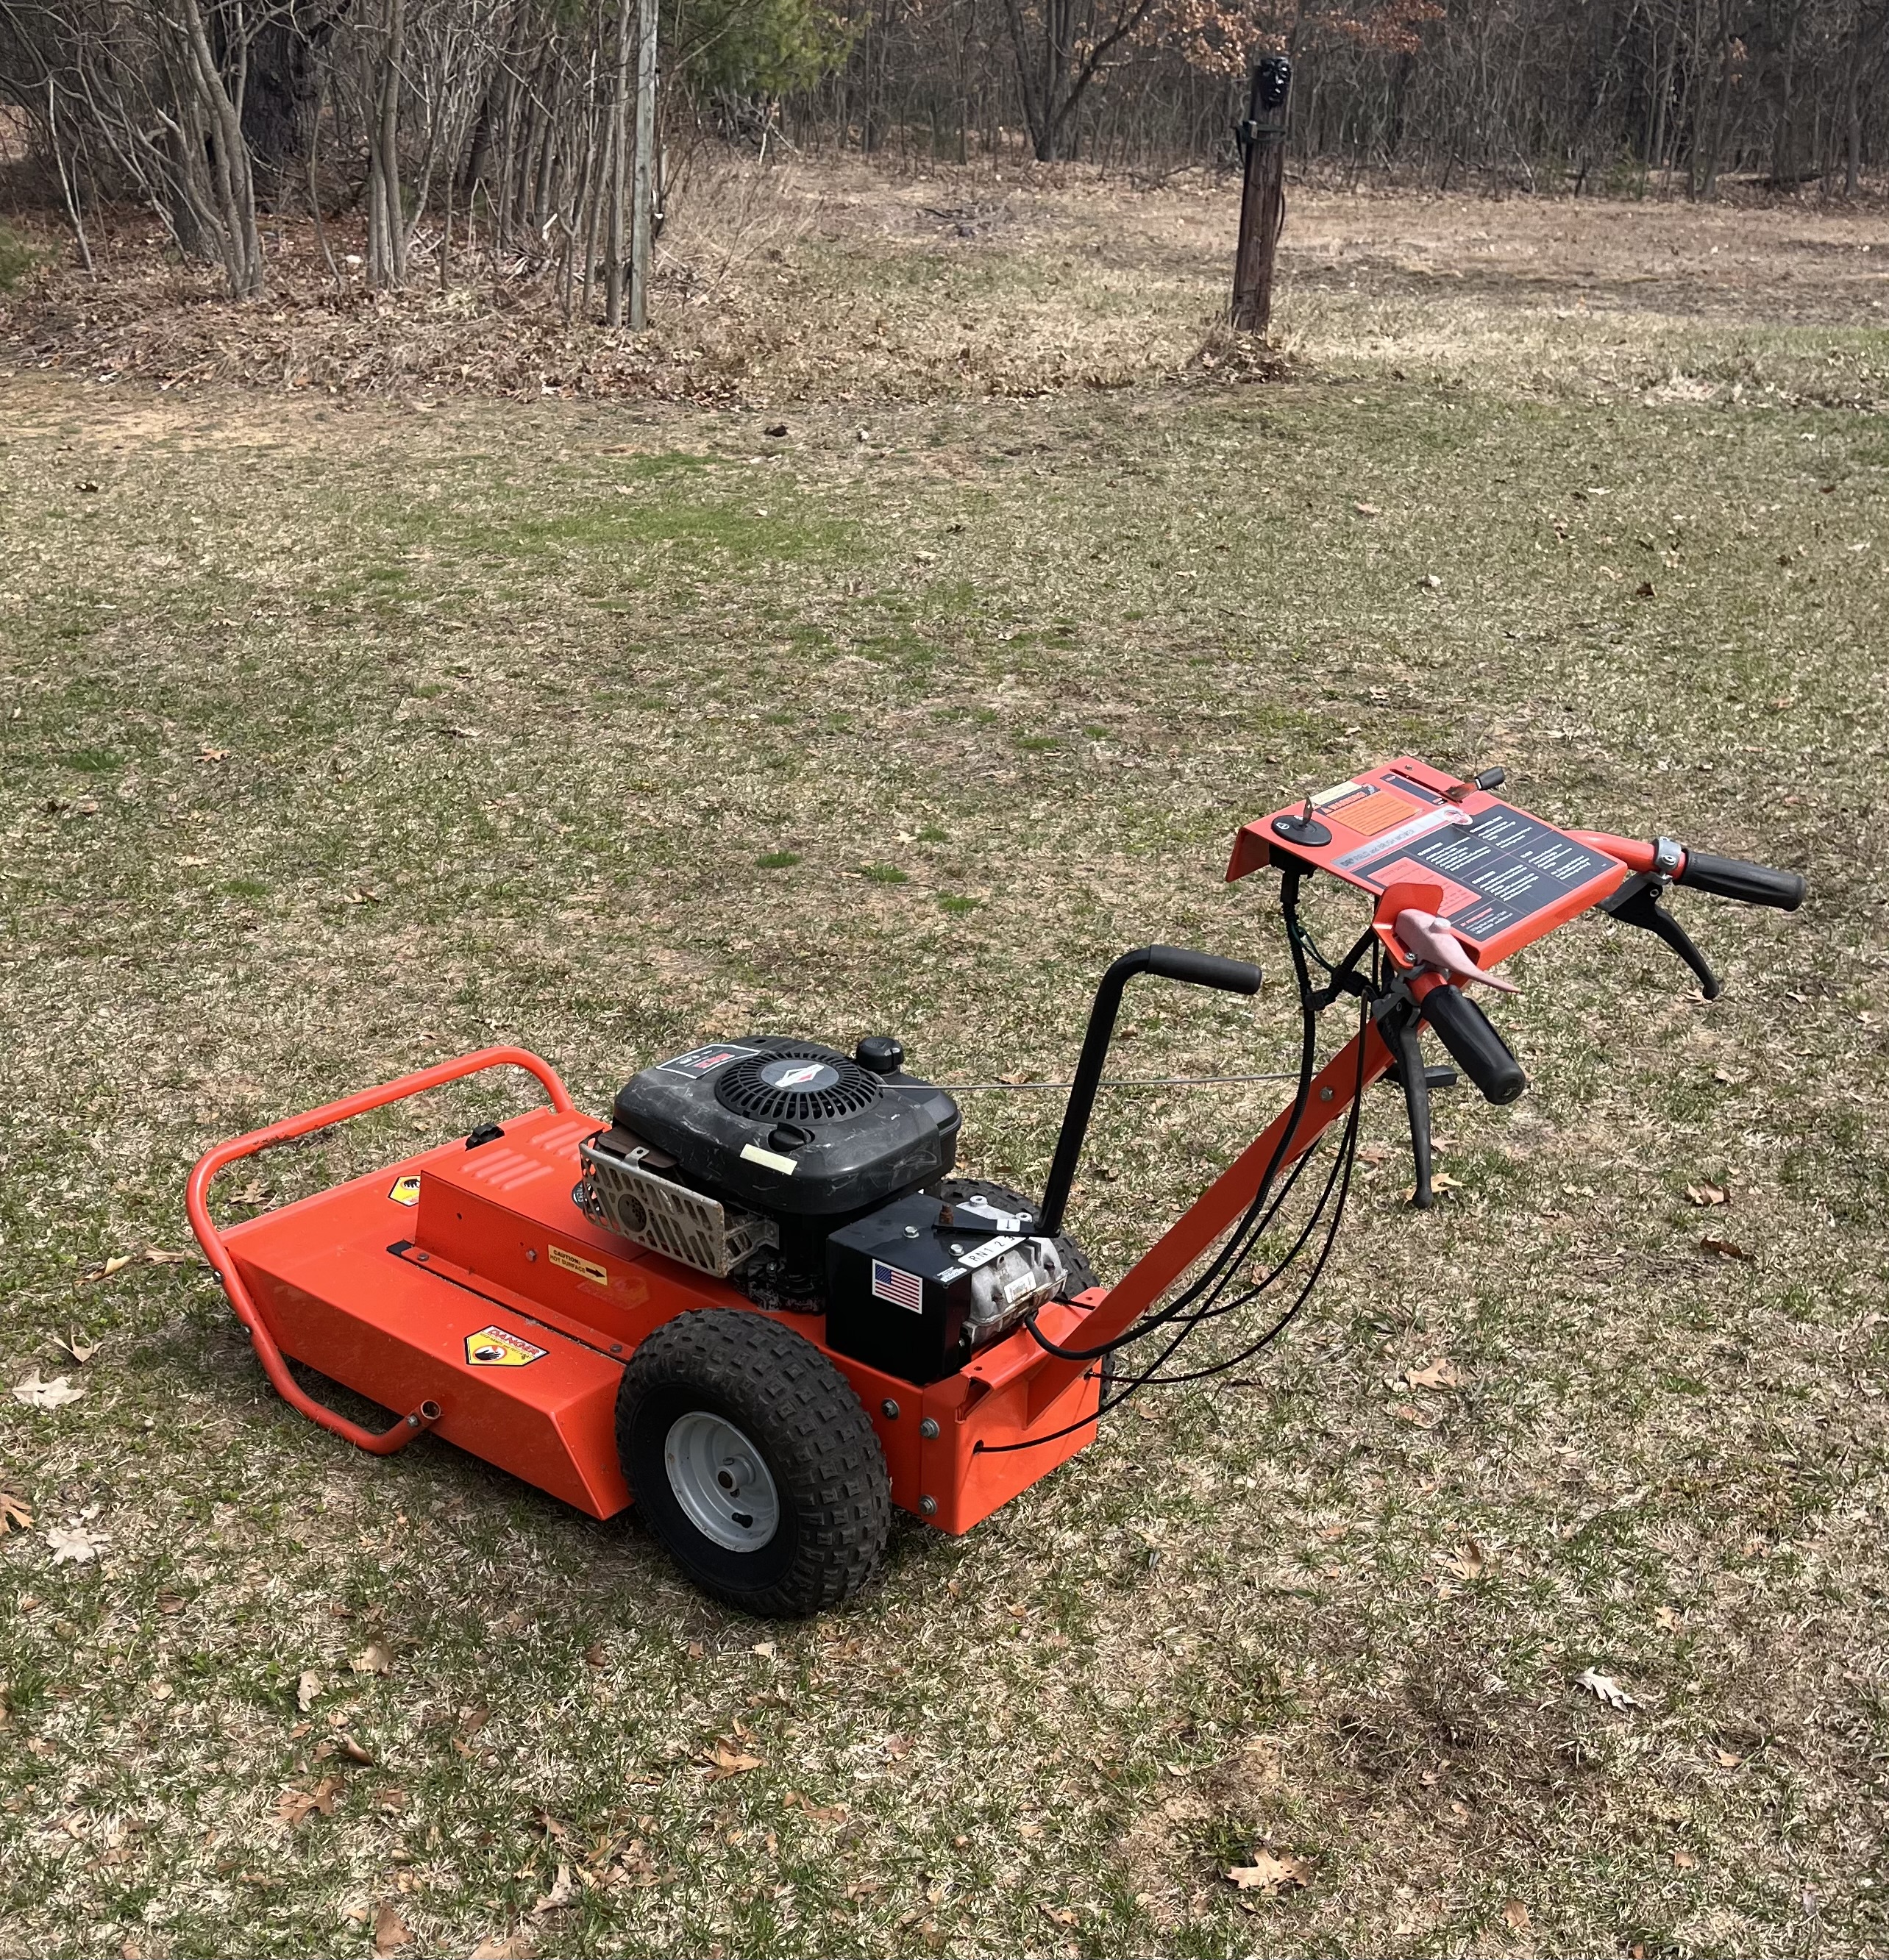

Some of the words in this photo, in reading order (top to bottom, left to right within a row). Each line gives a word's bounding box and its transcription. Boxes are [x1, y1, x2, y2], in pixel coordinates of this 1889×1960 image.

[549, 1255, 561, 1263] HOT
[561, 1259, 586, 1273] SURFACE
[487, 1329, 540, 1355] DANGER
